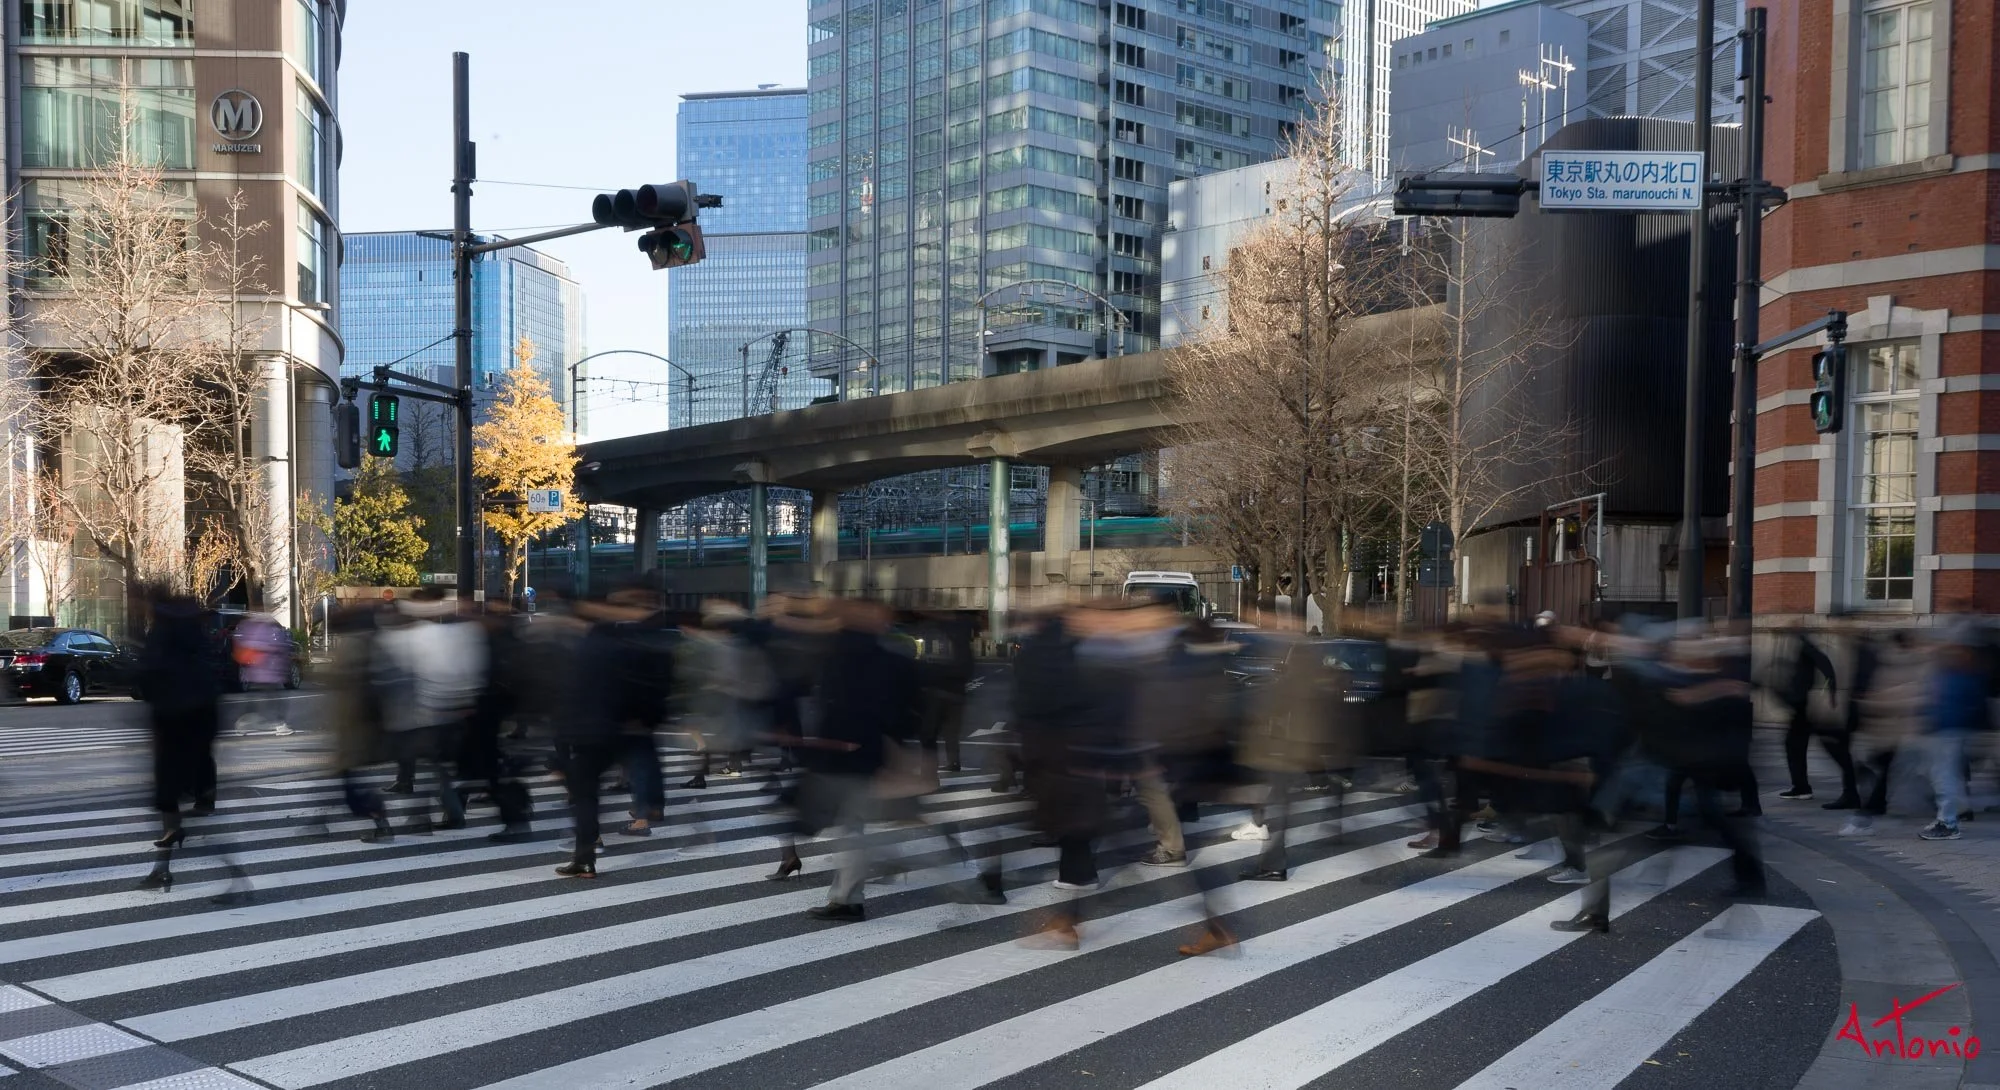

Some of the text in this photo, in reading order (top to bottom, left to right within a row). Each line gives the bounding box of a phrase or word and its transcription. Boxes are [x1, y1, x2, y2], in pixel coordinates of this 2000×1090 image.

[217, 98, 253, 131] M
[212, 143, 261, 153] MARUZEN
[1546, 160, 1697, 184] 東京駅丸の内北口
[1549, 186, 1694, 202] Tokyo Sta. marunouchi N.
[551, 491, 558, 501] P
